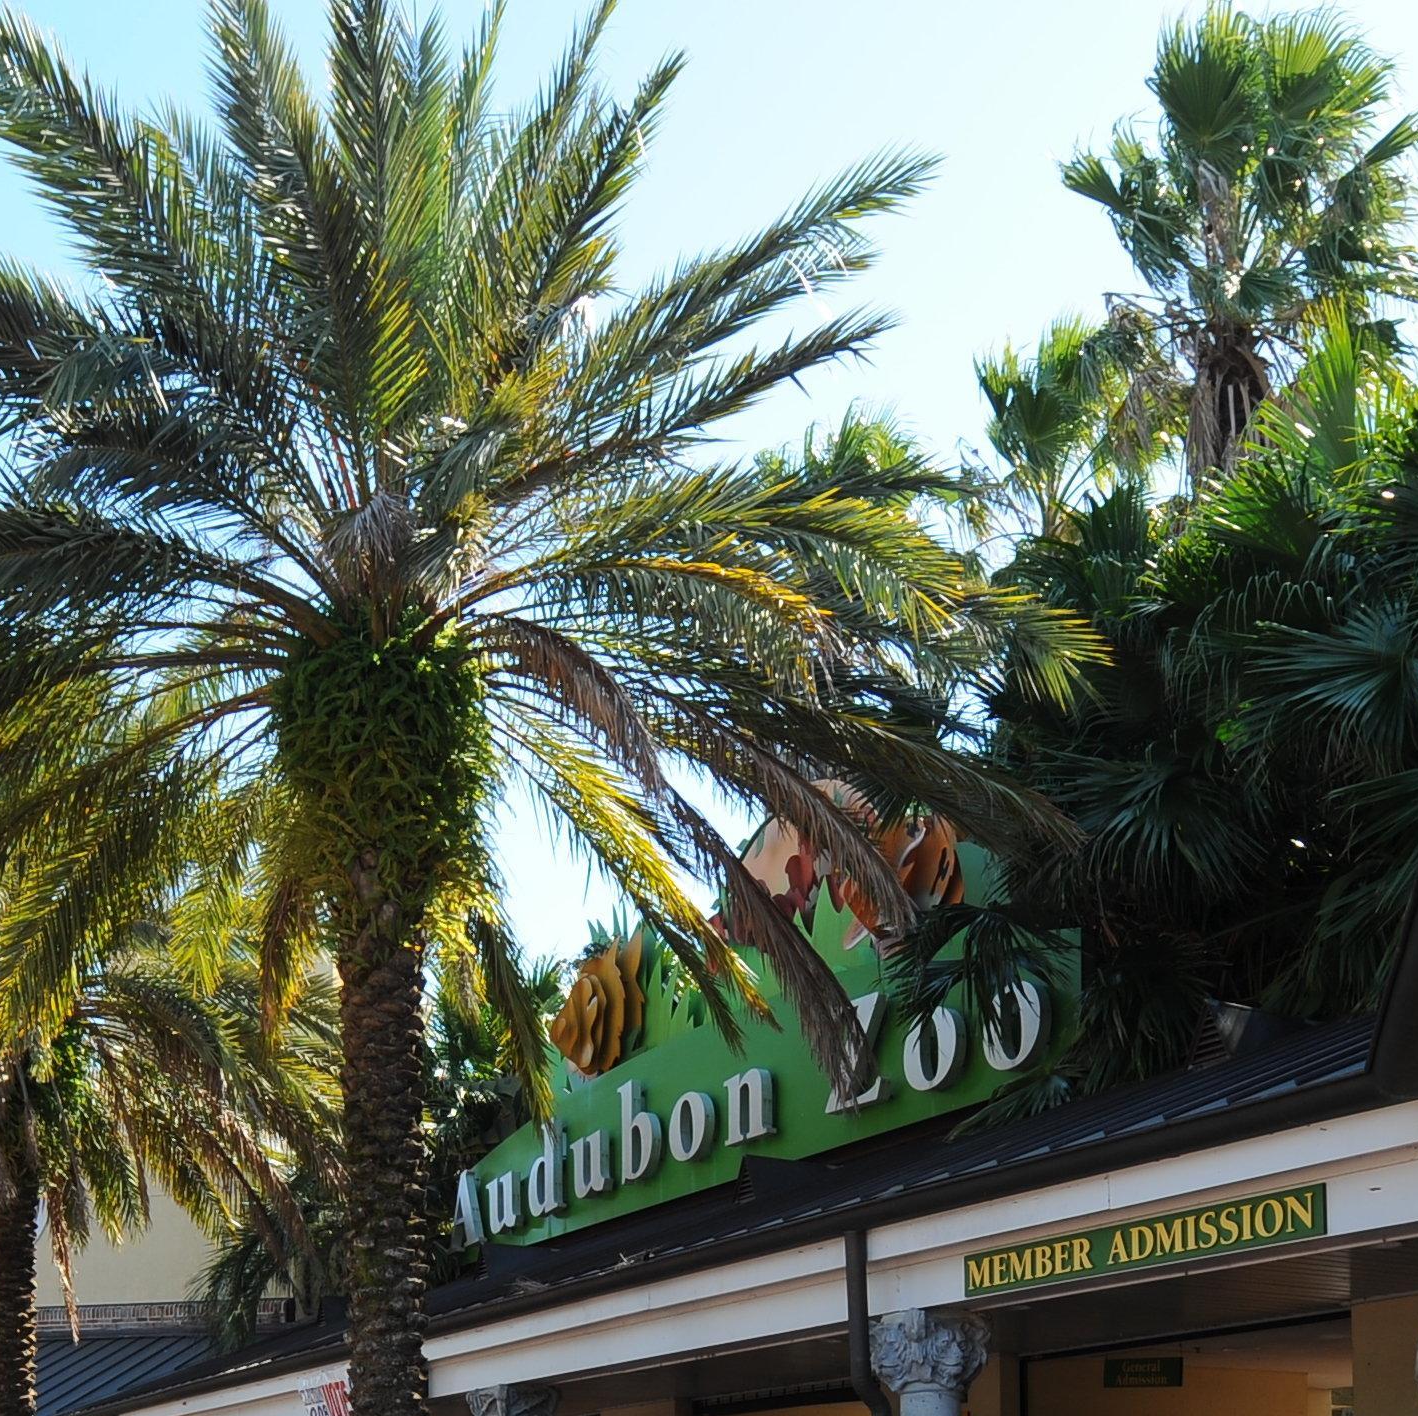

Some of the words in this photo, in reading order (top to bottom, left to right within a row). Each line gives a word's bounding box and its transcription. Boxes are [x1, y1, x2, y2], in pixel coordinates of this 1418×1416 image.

[451, 1066, 774, 1250] Audubon
[825, 979, 1044, 1114] Zoo
[967, 1237, 1094, 1291] MEMBER
[1106, 1191, 1315, 1266] ADMISSION
[1117, 1374, 1169, 1386] Admission
[1122, 1359, 1161, 1373] General
